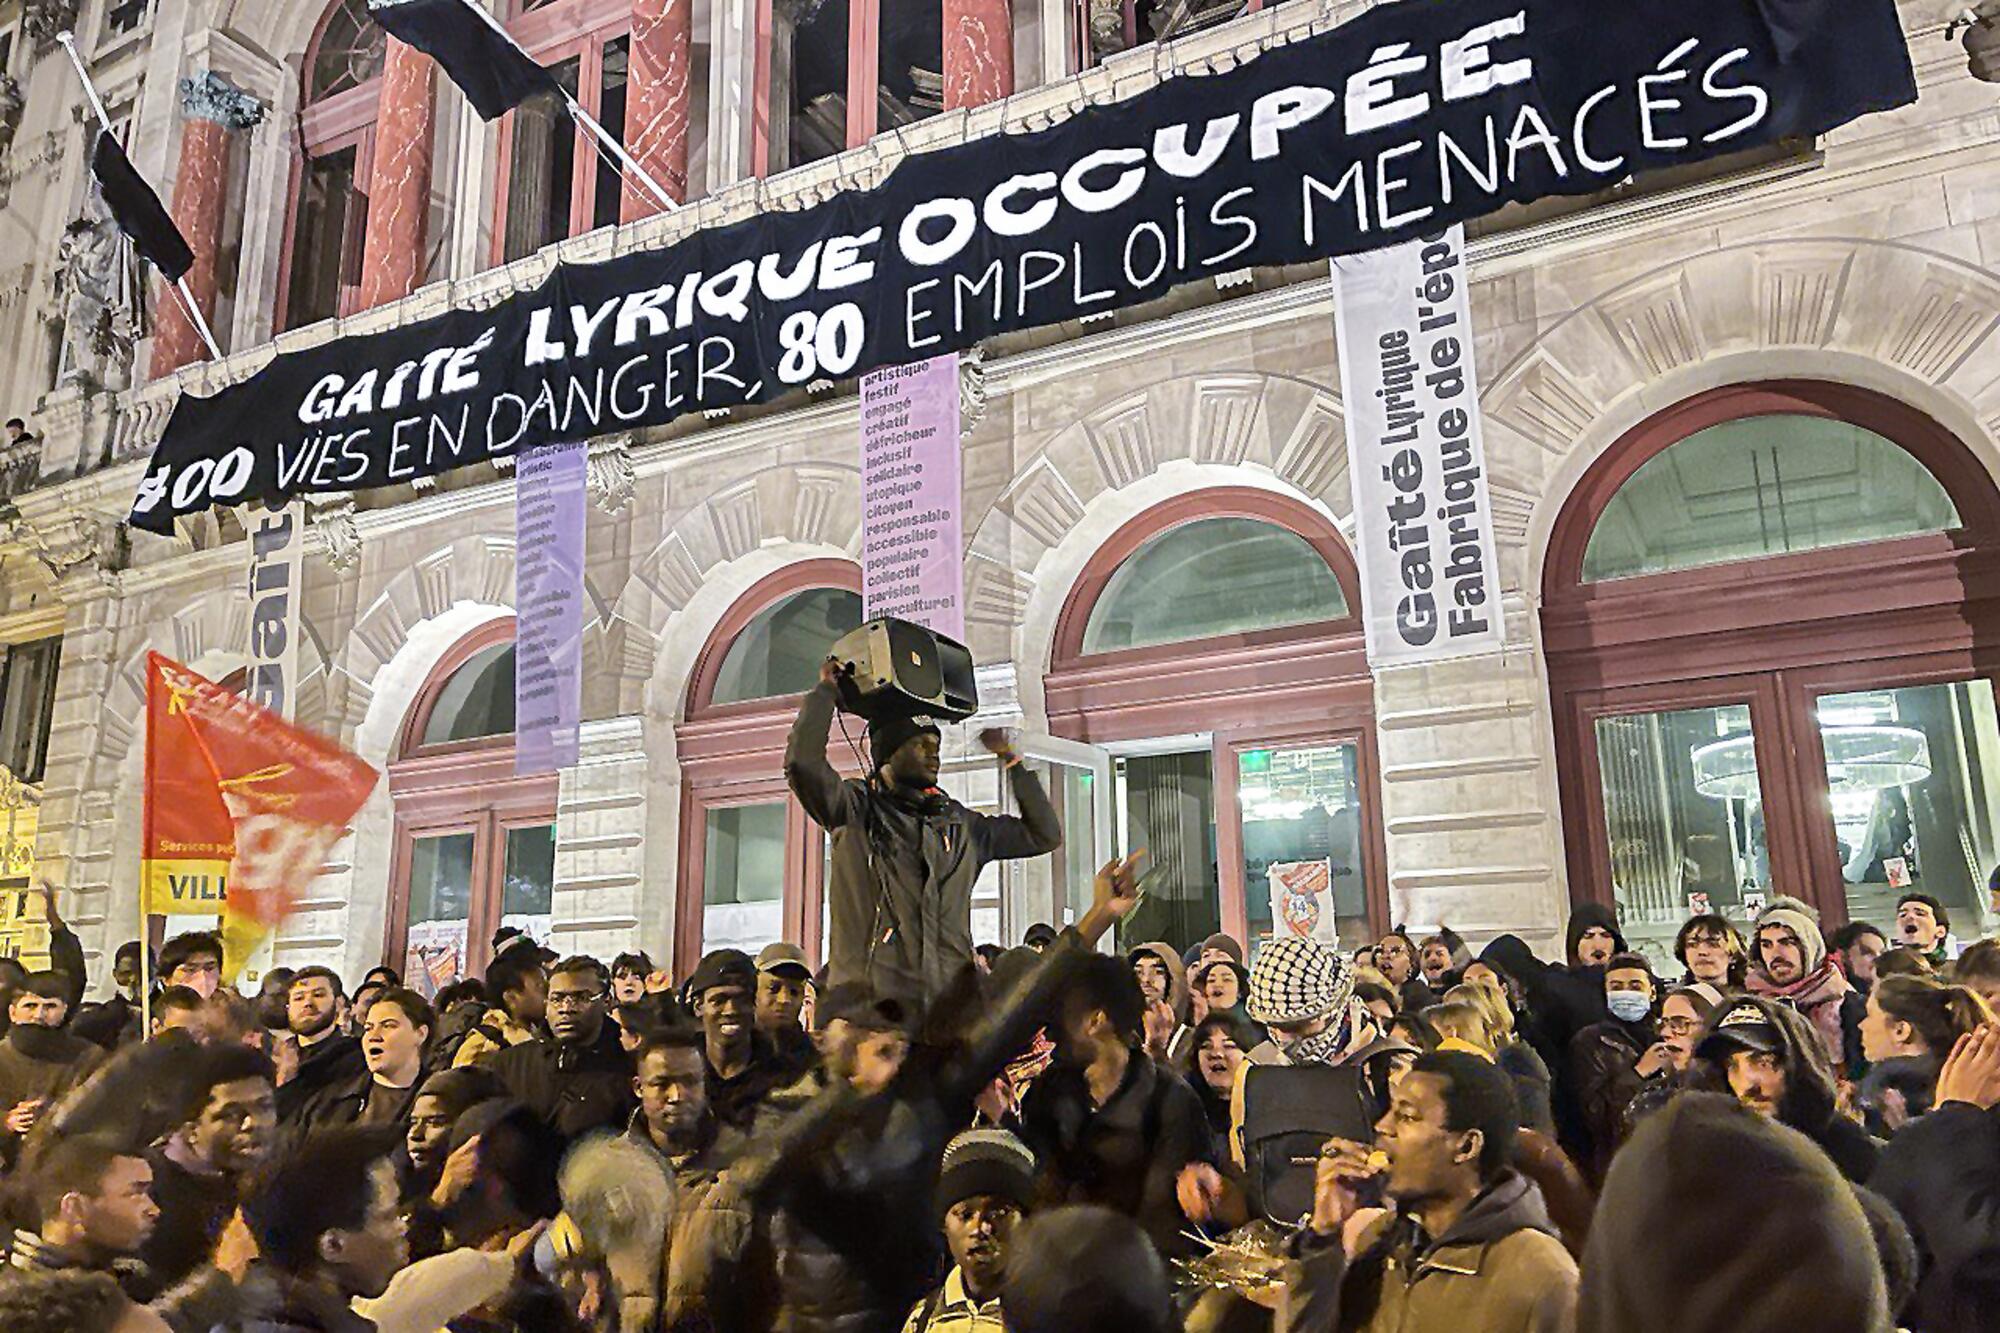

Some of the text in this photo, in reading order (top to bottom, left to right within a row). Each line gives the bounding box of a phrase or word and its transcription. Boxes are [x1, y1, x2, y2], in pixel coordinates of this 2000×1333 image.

[525, 226, 882, 367] LYRIQUE
[898, 10, 1533, 266] OCCUPÉE
[276, 427, 371, 490] VIES
[387, 403, 471, 470] EN
[486, 335, 763, 449] DANGER,
[777, 302, 865, 381] 80
[905, 186, 1258, 350] EMPLOIS
[1302, 37, 1769, 246] MENACÉS
[864, 362, 929, 387] artistique
[1426, 335, 1465, 400] de
[865, 383, 900, 403] festif
[865, 397, 912, 419] engagé
[865, 414, 910, 436] créatif
[866, 446, 912, 469] inclusif
[866, 463, 923, 486] solidaire
[866, 480, 923, 502] utopique
[1374, 329, 1439, 647] Gaîté Lyrique
[866, 499, 913, 519] citoyen
[867, 509, 951, 536] responsable
[1437, 406, 1489, 639] Fabrique
[867, 528, 938, 553] accessible
[867, 547, 929, 572] populaire
[867, 563, 921, 587] collectif
[868, 583, 920, 607] parisien
